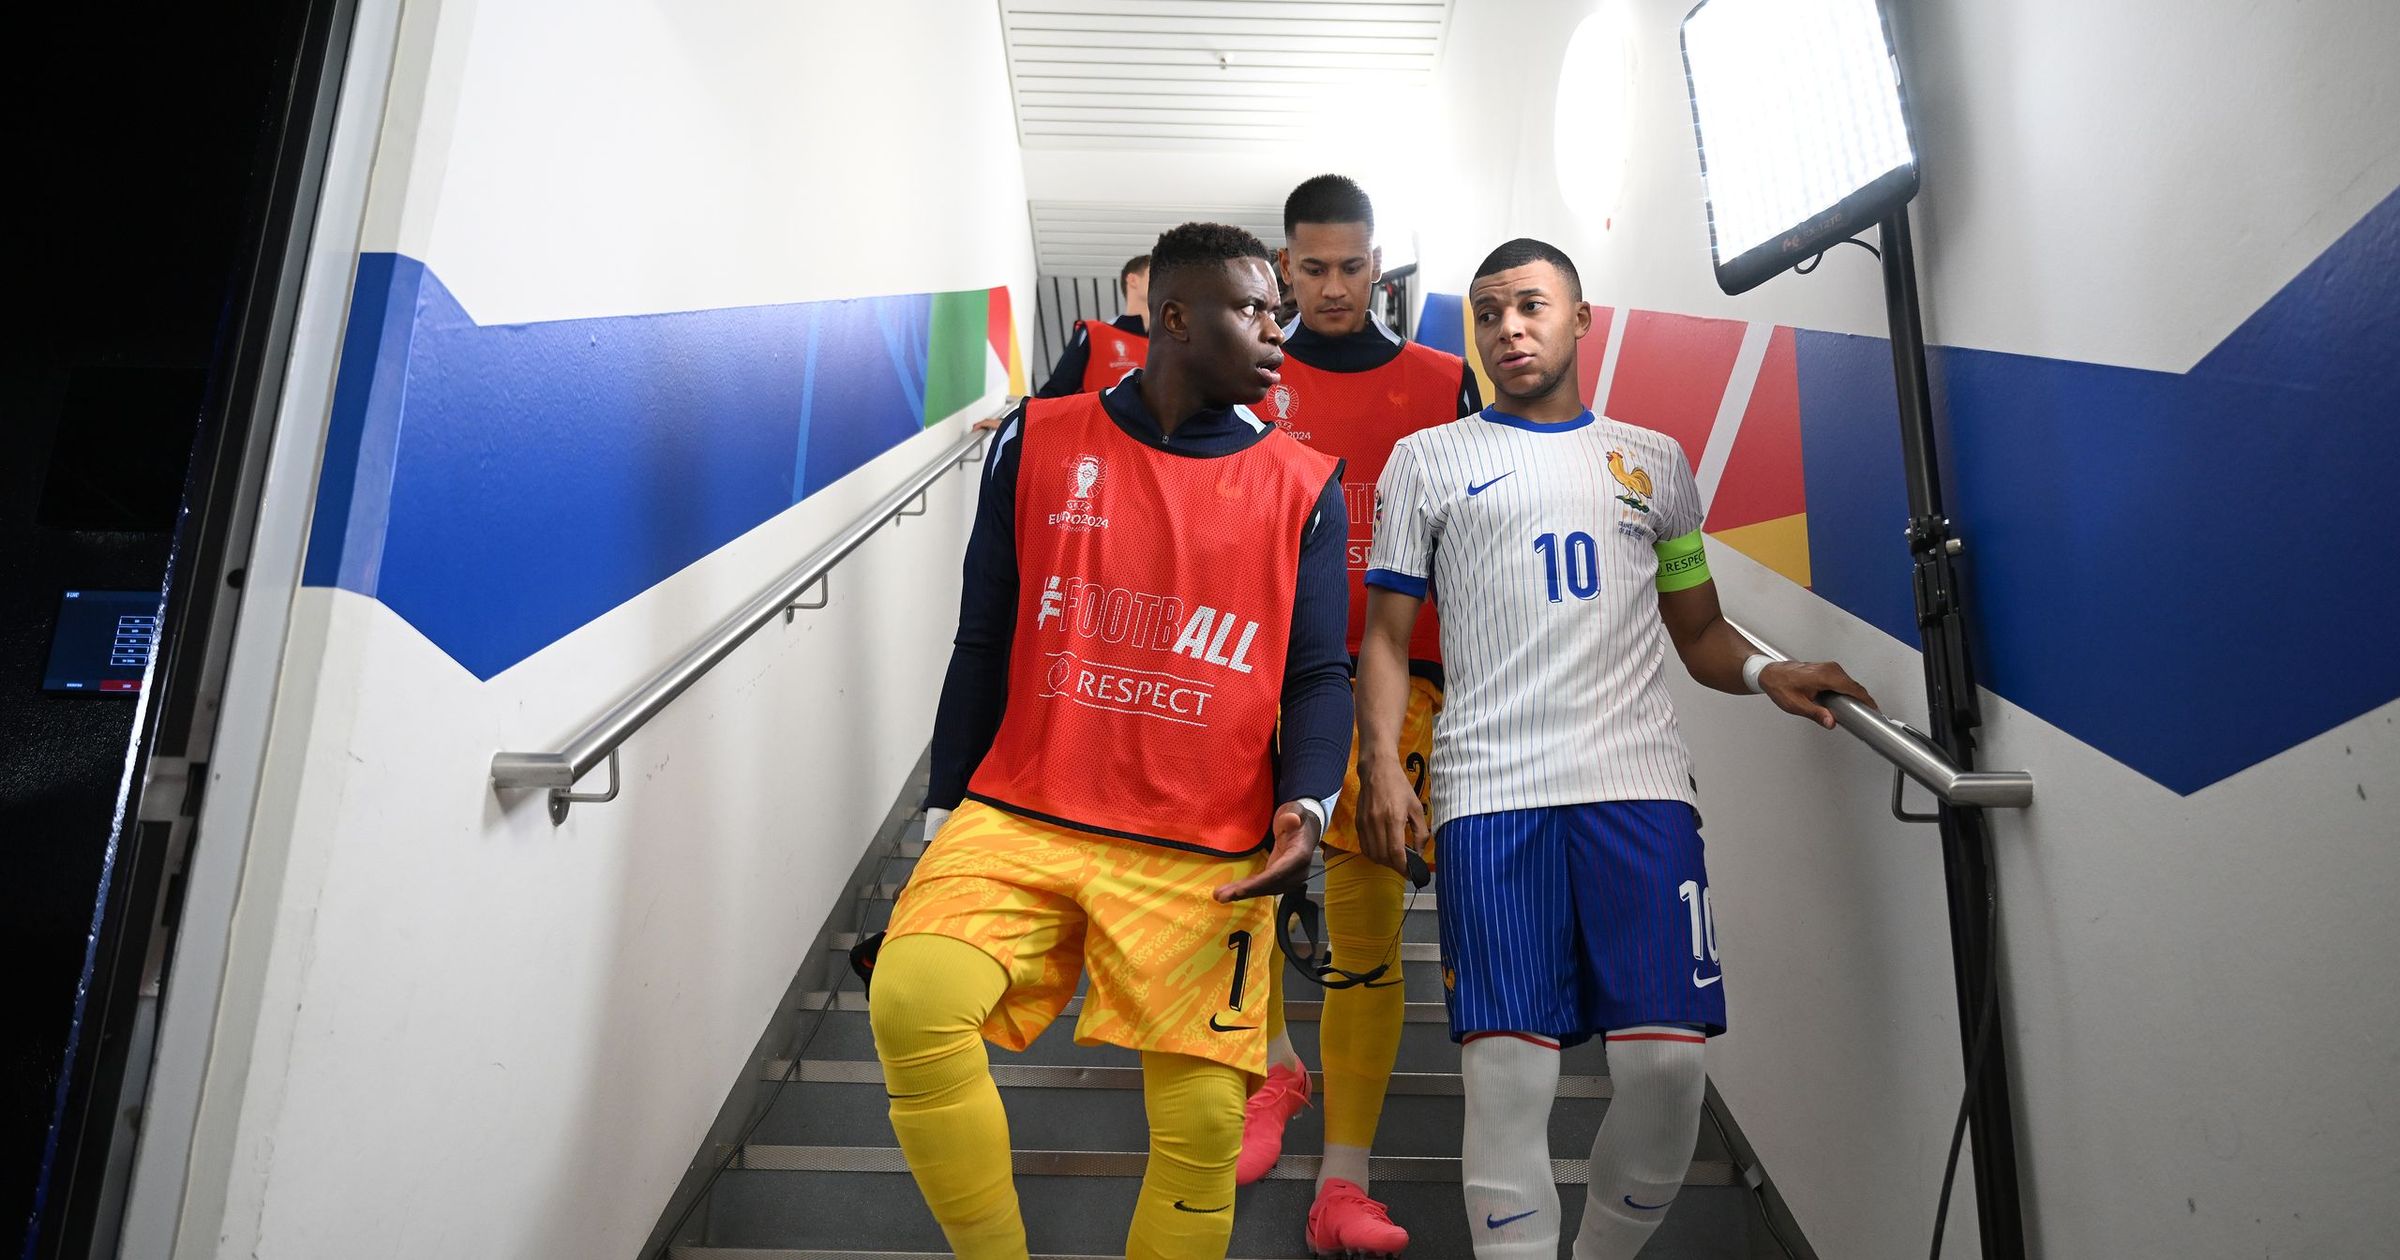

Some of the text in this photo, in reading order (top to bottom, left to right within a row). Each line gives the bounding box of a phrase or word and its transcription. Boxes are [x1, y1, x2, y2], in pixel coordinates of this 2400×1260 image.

[1533, 531, 1602, 603] 10
[1665, 550, 1704, 573] RESPEC
[1037, 575, 1260, 674] #FOOTBALL
[1076, 670, 1212, 716] RESPECT
[1228, 930, 1252, 1012] 1
